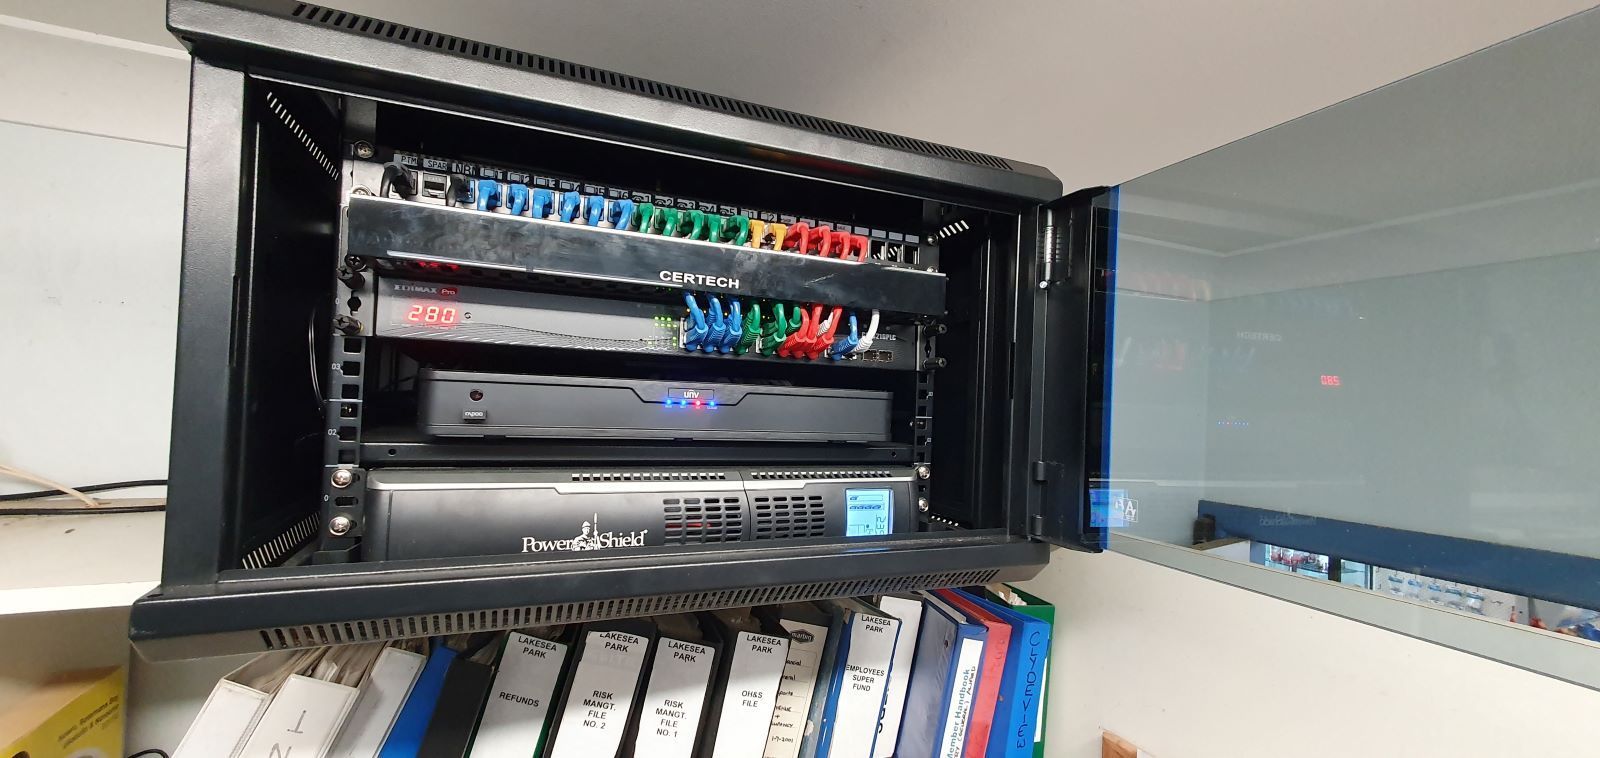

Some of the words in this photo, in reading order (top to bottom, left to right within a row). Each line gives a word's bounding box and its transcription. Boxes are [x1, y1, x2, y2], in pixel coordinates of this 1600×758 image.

[659, 270, 740, 289] CERTECH
[407, 304, 456, 324] 280
[860, 615, 892, 627] LAKESEA
[865, 624, 884, 634] PARK
[518, 635, 557, 652] LAKESEA
[746, 634, 782, 646] LAKESEA
[523, 647, 547, 659] PARK
[604, 641, 629, 653] PARK
[667, 640, 706, 655] LAKESEA
[751, 644, 773, 654] PARK
[673, 651, 697, 663] PARK
[845, 664, 885, 677] EMPLOYEES
[852, 674, 875, 684] SUPER
[852, 683, 871, 692] FUND
[499, 691, 540, 708] REFUNDS
[592, 690, 614, 700] RISK
[741, 690, 763, 699] OH&S
[954, 669, 971, 719] Handbook
[582, 699, 617, 711] MANGT.
[663, 699, 684, 709] RISK
[742, 699, 758, 708] FILE
[587, 709, 607, 720] FILE
[655, 708, 688, 720] MANGT.
[583, 719, 598, 728] NO.
[660, 718, 679, 728] FILE
[656, 728, 670, 737] NO.
